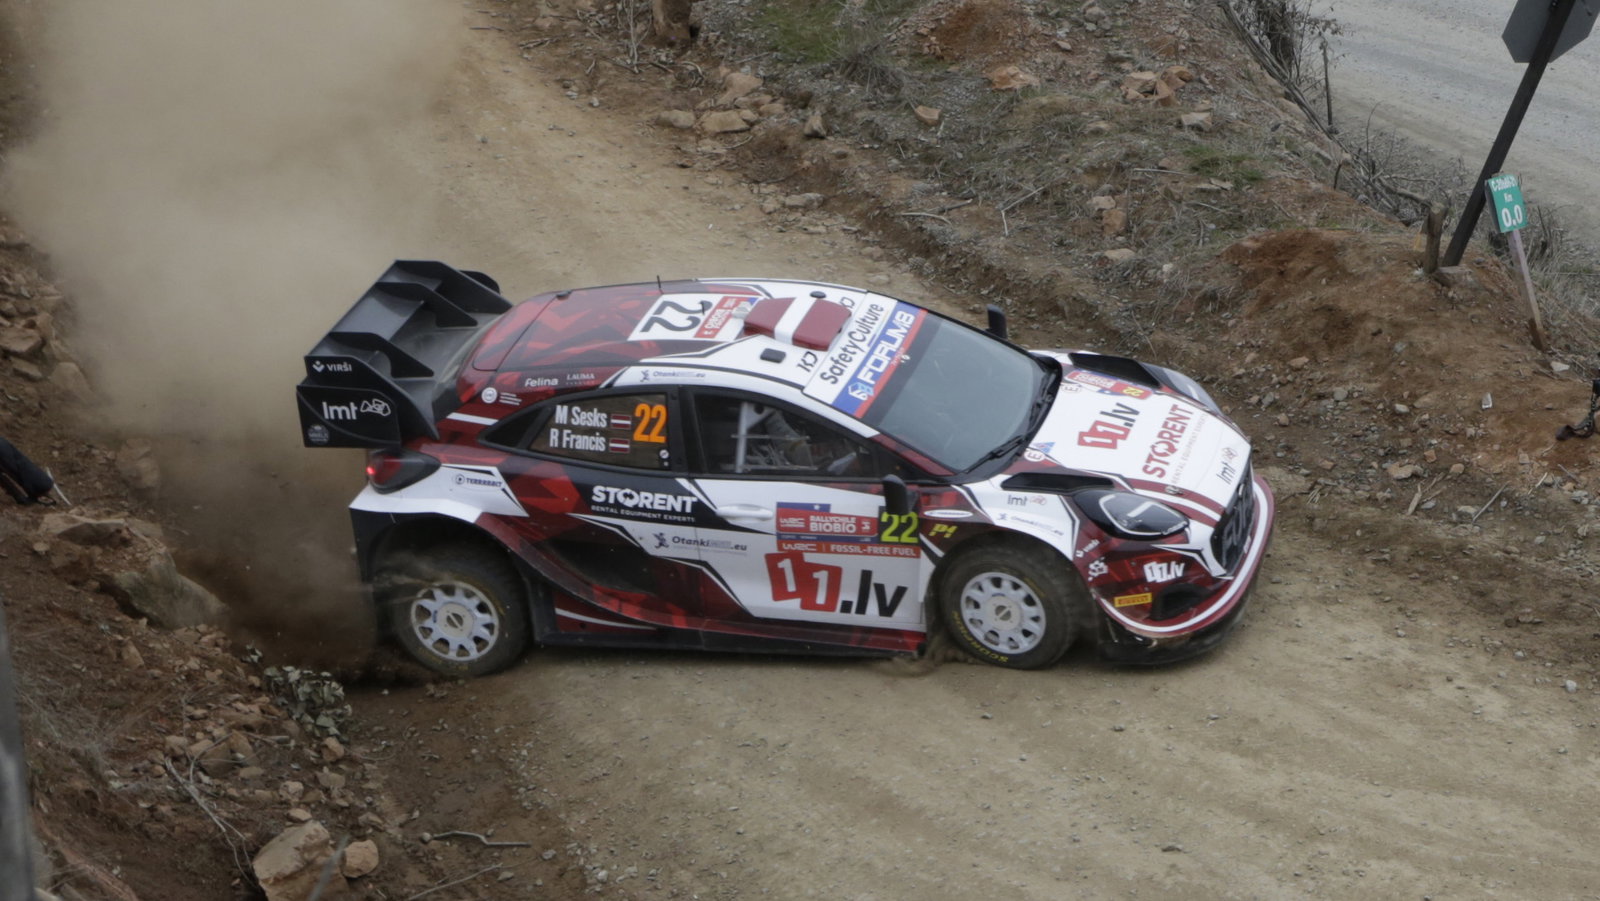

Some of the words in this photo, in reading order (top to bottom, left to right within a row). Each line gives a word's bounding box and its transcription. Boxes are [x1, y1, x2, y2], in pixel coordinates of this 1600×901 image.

[1501, 204, 1523, 227] 0.0
[640, 299, 713, 333] 22
[820, 303, 884, 385] SafetyCulture
[856, 310, 915, 384] FORUM8
[326, 362, 352, 371] VIRŠI
[525, 378, 558, 387] Felina
[322, 402, 358, 420] lmt
[555, 405, 568, 424] M
[571, 406, 607, 428] Sesks
[633, 403, 667, 443] 22
[549, 428, 559, 447] R
[562, 429, 606, 452] Francis
[1142, 404, 1194, 478] STORENT
[591, 485, 698, 513] STORENT
[591, 505, 618, 514] RENTAL
[620, 509, 662, 519] EQUIPMENT
[664, 514, 696, 523] EXPERTS
[881, 511, 919, 543] 22
[830, 544, 891, 555] FOSSIL-FREE
[892, 546, 916, 556] FUEL
[771, 556, 909, 617] 11.lv
